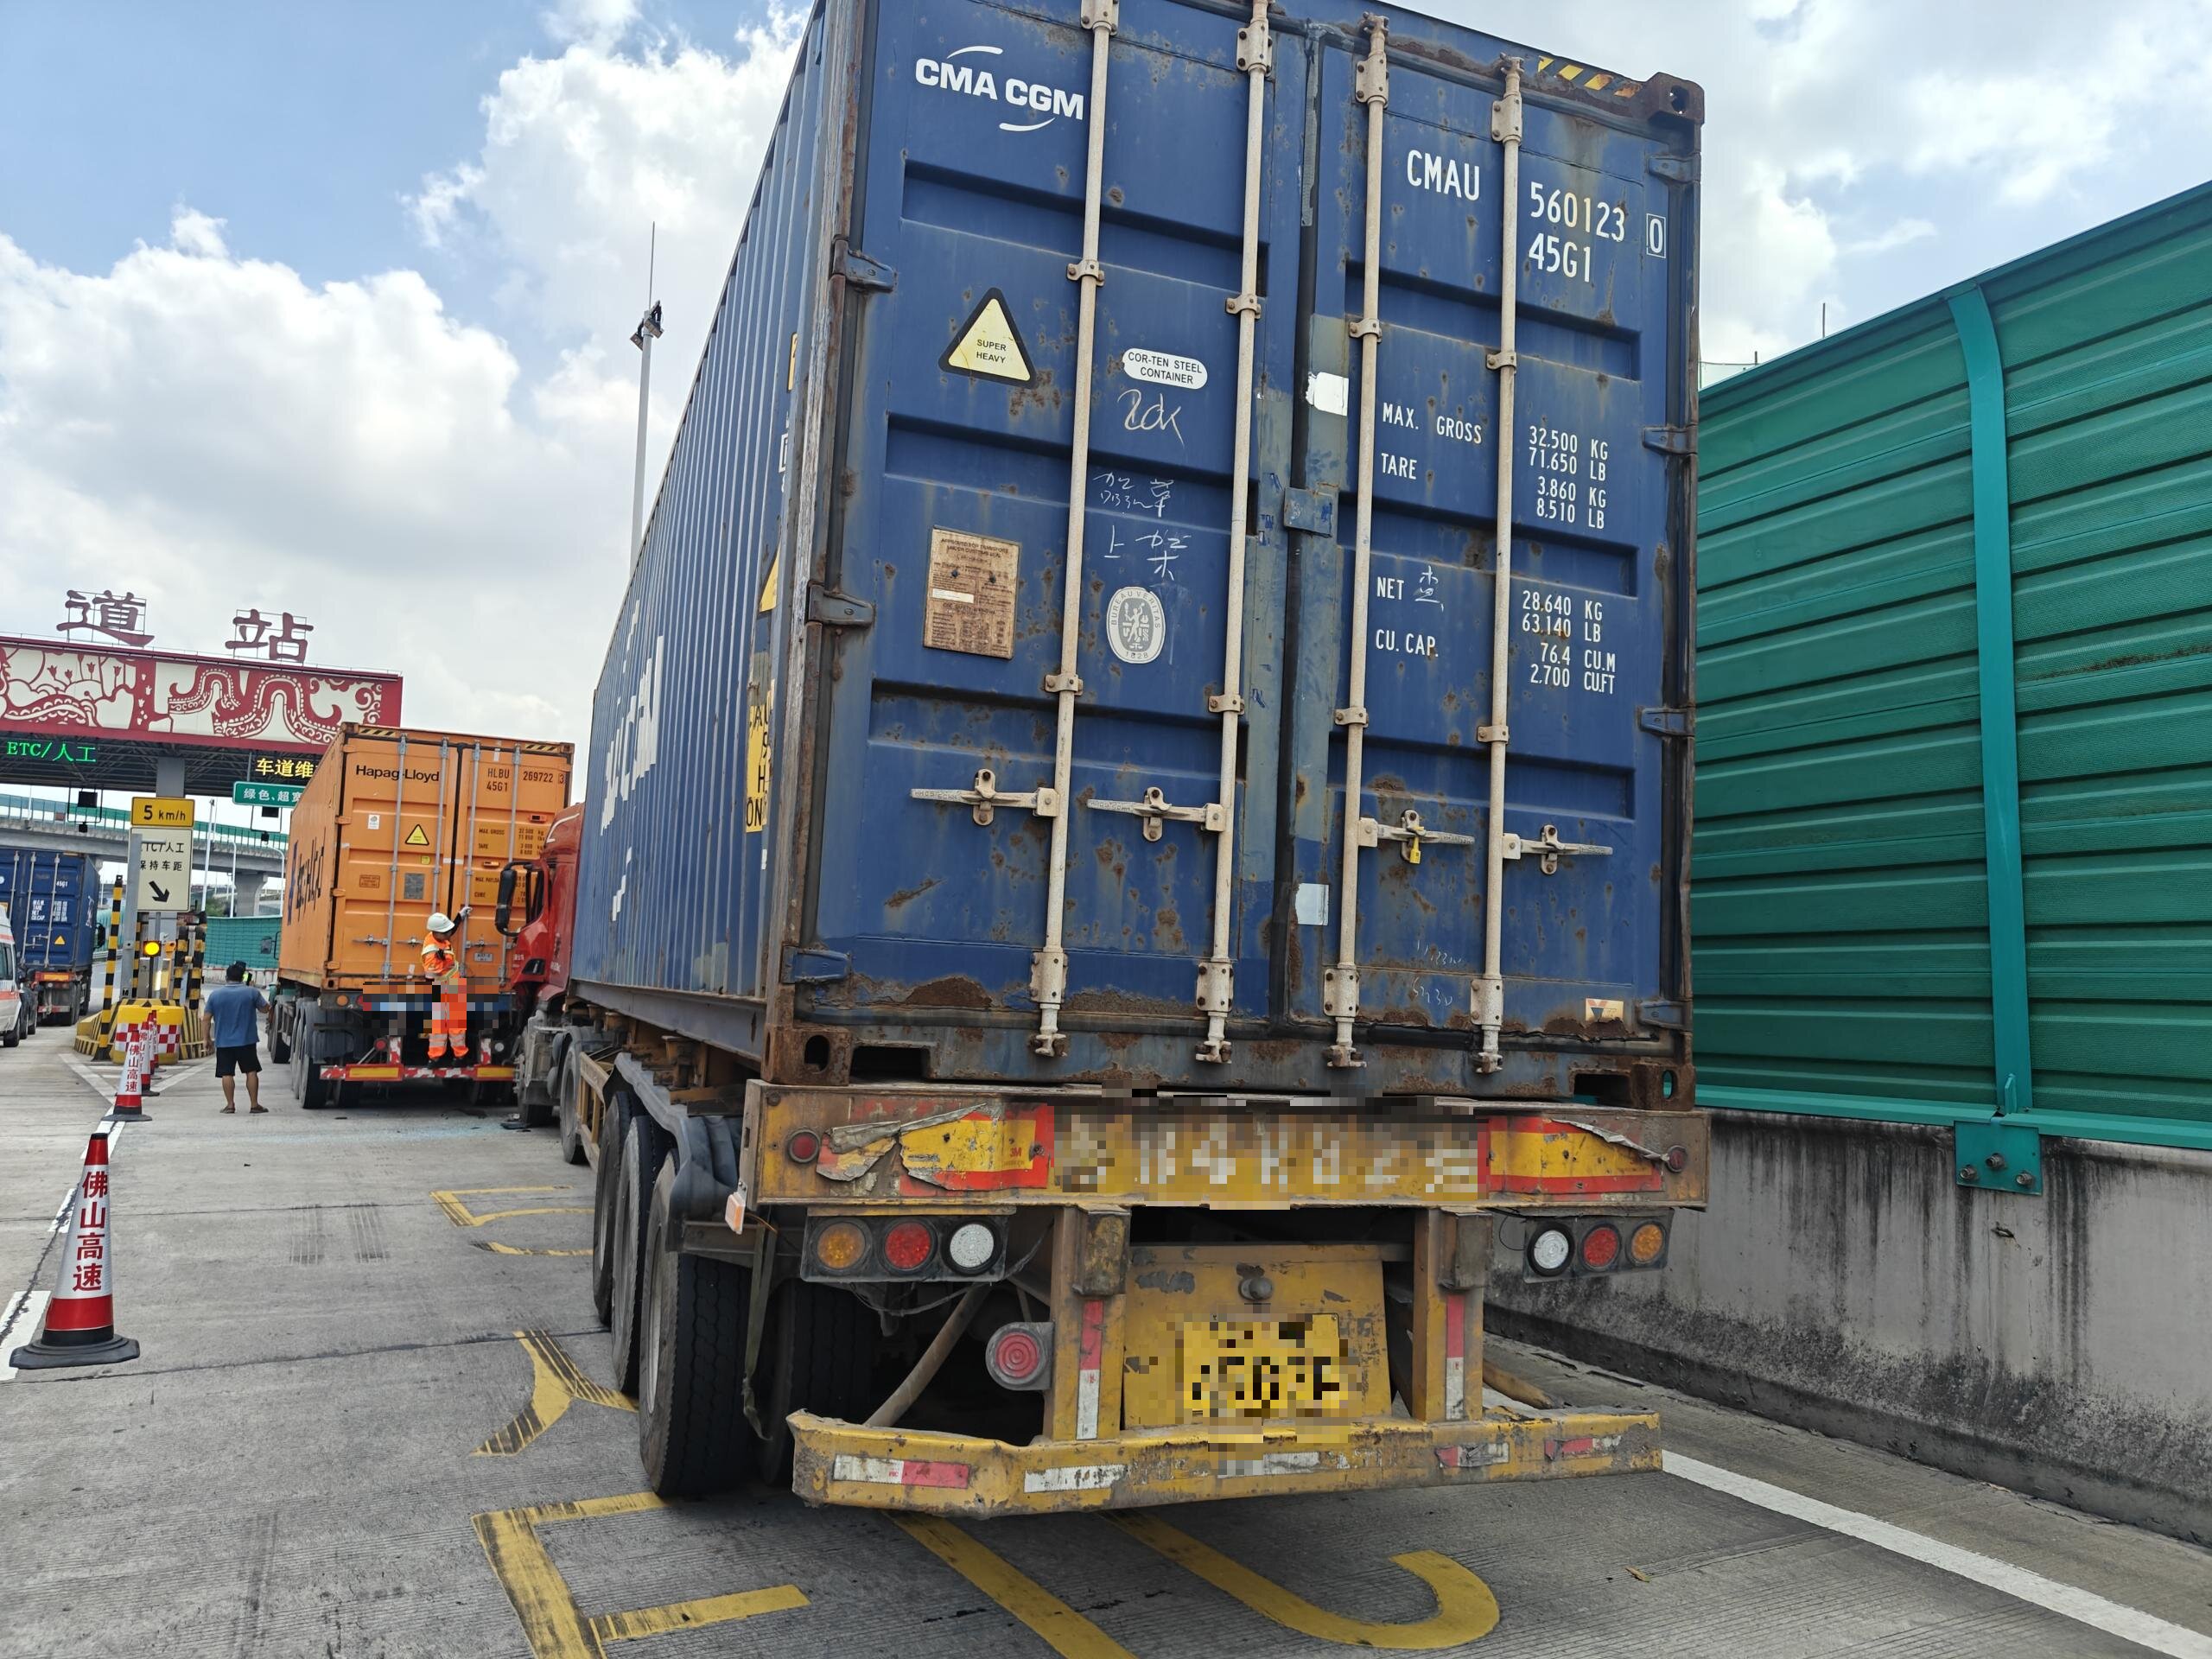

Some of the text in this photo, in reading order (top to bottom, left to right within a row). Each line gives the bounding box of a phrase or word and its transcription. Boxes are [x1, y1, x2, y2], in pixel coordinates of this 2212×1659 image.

[915, 58, 1084, 120] CMA CGM
[1407, 149, 1480, 200] CMAU
[1529, 181, 1663, 254] 560123 0
[1529, 232, 1591, 283] 45G1
[976, 339, 1007, 352] SUPER
[976, 351, 1006, 364] HEAVY
[1128, 352, 1202, 373] COR-TEN STEEL
[1140, 366, 1193, 384] CONTAINER
[1382, 403, 1483, 444] MAX. GROSS
[1591, 439, 1609, 461] KG
[1381, 453, 1418, 480] TARE
[1590, 461, 1606, 481] LB
[1588, 486, 1607, 508] KG
[1588, 510, 1605, 529] LB
[1376, 576, 1404, 601] NET
[1584, 601, 1603, 621] KG
[1584, 622, 1601, 642] LB
[1376, 629, 1439, 658] CU. CAP.
[1540, 642, 1616, 673] 76.4 CU.M
[6, 741, 97, 764] ETC/人工
[255, 757, 317, 779] 车道维
[487, 767, 510, 779] HLBU
[523, 771, 554, 783] 269722
[486, 781, 508, 791] 45G1
[143, 804, 186, 822] 5 km/h
[125, 1044, 139, 1092] 佛山高速
[72, 1170, 109, 1293] 佛山高速
